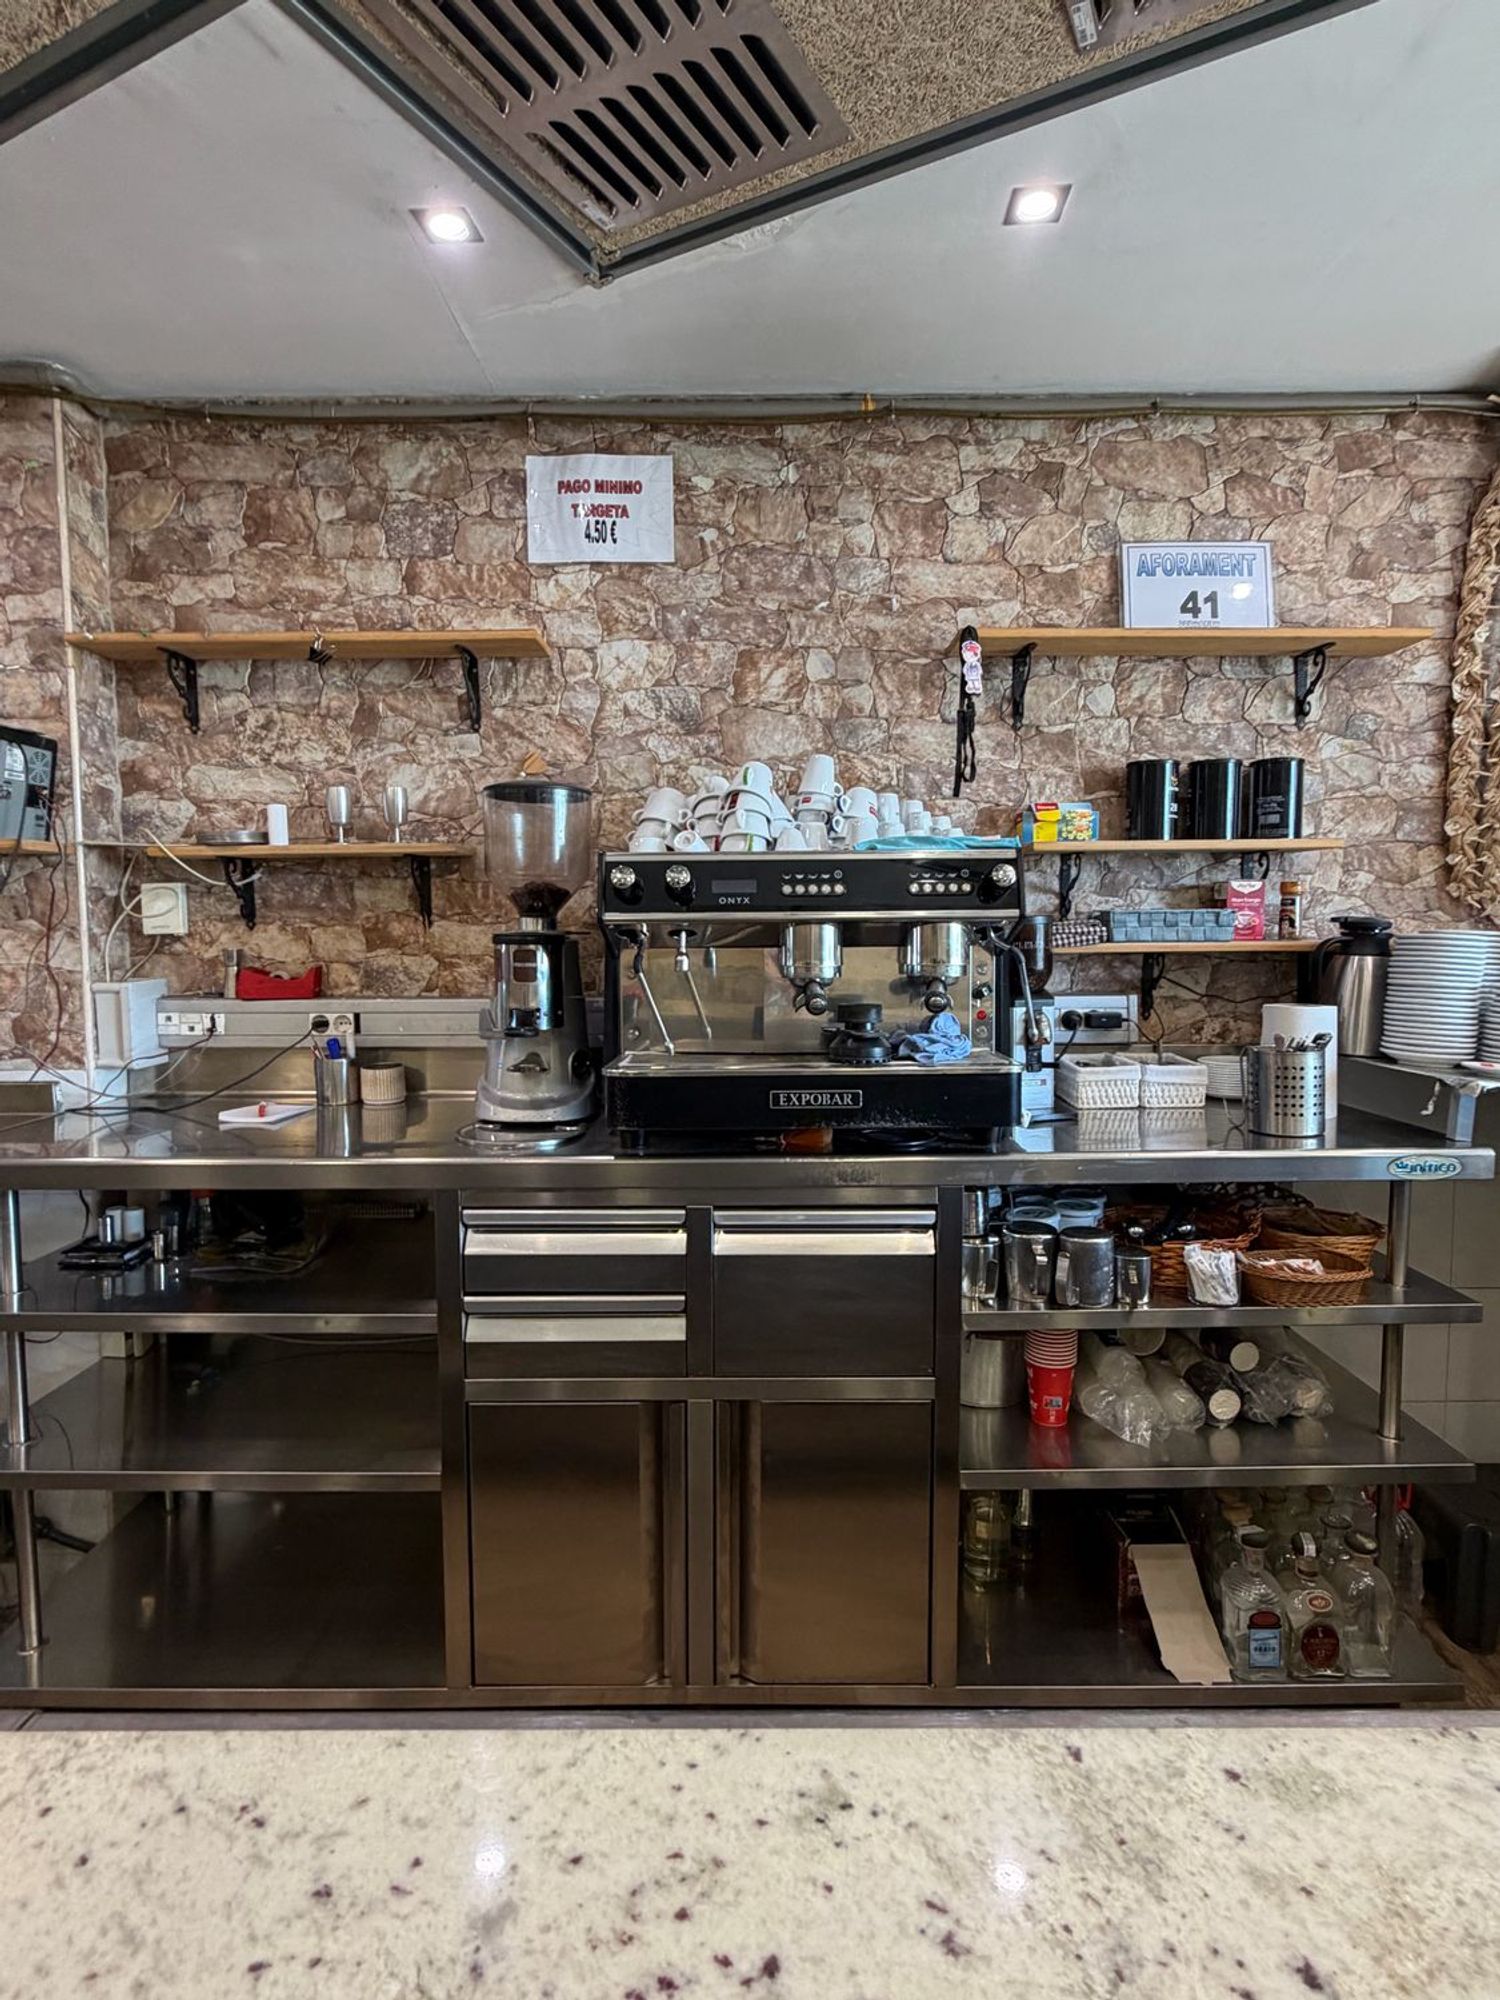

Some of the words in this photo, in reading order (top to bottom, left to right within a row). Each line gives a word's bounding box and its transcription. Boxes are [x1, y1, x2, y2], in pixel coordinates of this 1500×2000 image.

[557, 479, 591, 495] PAGO
[594, 479, 643, 495] MINIMO
[610, 521, 618, 544] €
[1136, 552, 1257, 577] AFORAMENT
[1179, 590, 1219, 619] 41
[718, 897, 751, 905] ONYX
[779, 1093, 854, 1106] EXPOBAR
